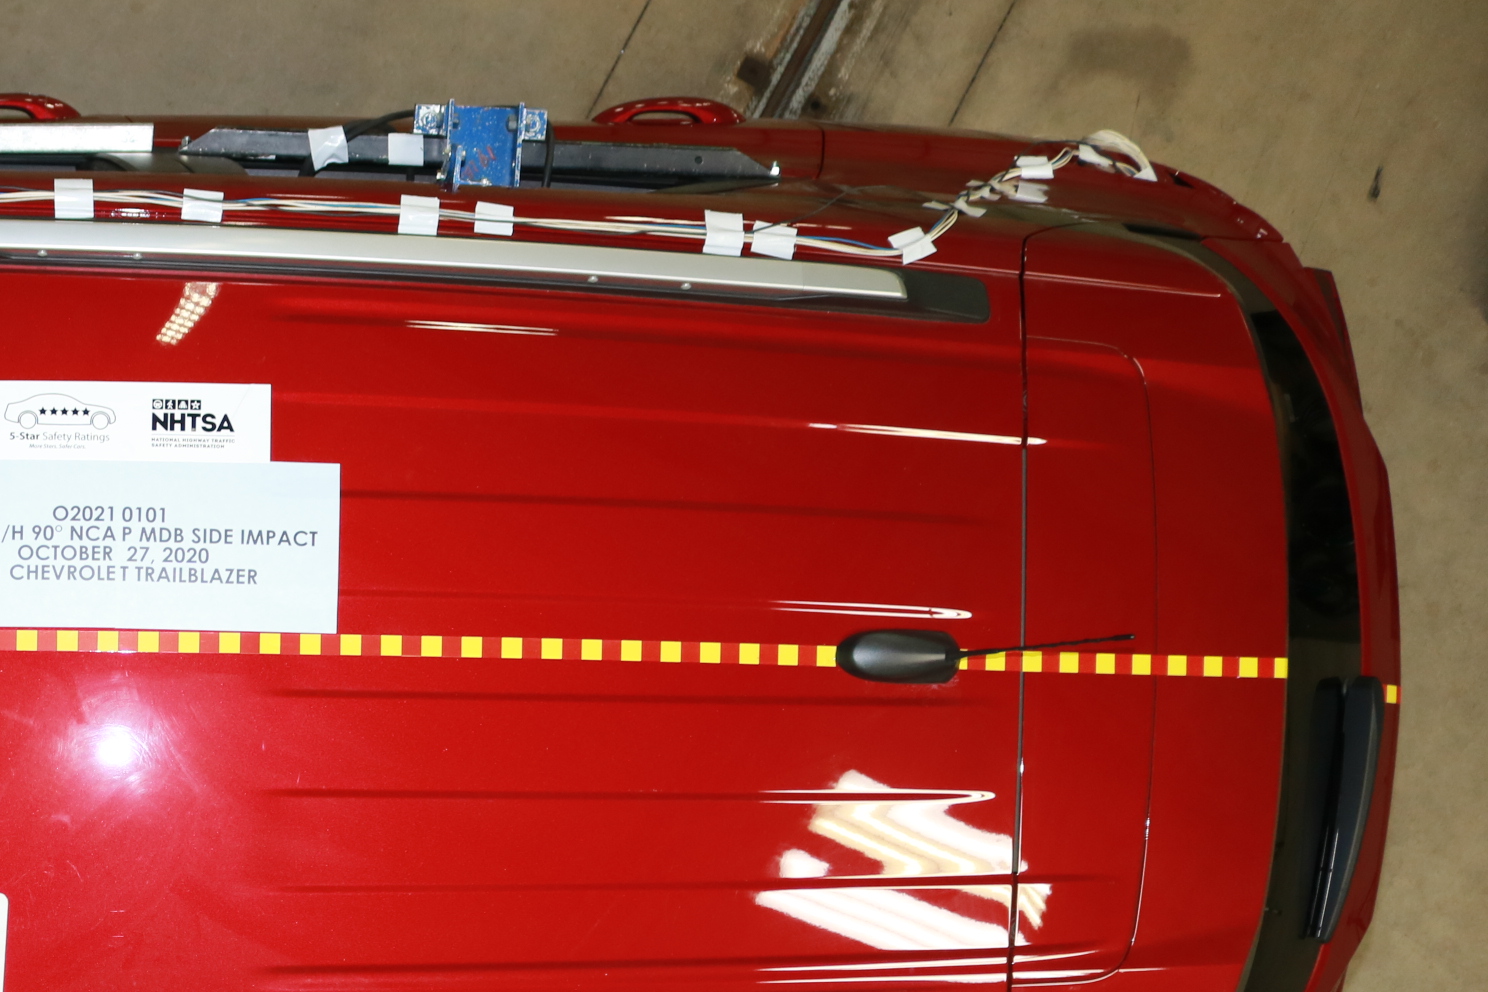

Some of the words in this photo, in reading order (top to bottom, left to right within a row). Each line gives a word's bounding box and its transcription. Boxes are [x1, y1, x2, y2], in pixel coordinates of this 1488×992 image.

[151, 412, 235, 432] NHTSA
[9, 431, 40, 441] 5-Star
[42, 431, 72, 443] Safety
[74, 432, 110, 443] Ratings
[139, 527, 184, 543] MDB
[191, 527, 233, 545] SIDE
[240, 529, 318, 546] IMPACT
[17, 544, 113, 561] OCTOBER
[126, 546, 155, 564] 27,
[162, 547, 209, 564] 2020
[9, 564, 129, 582] CHEVROLET
[135, 566, 258, 585] TRAILBLAZER
